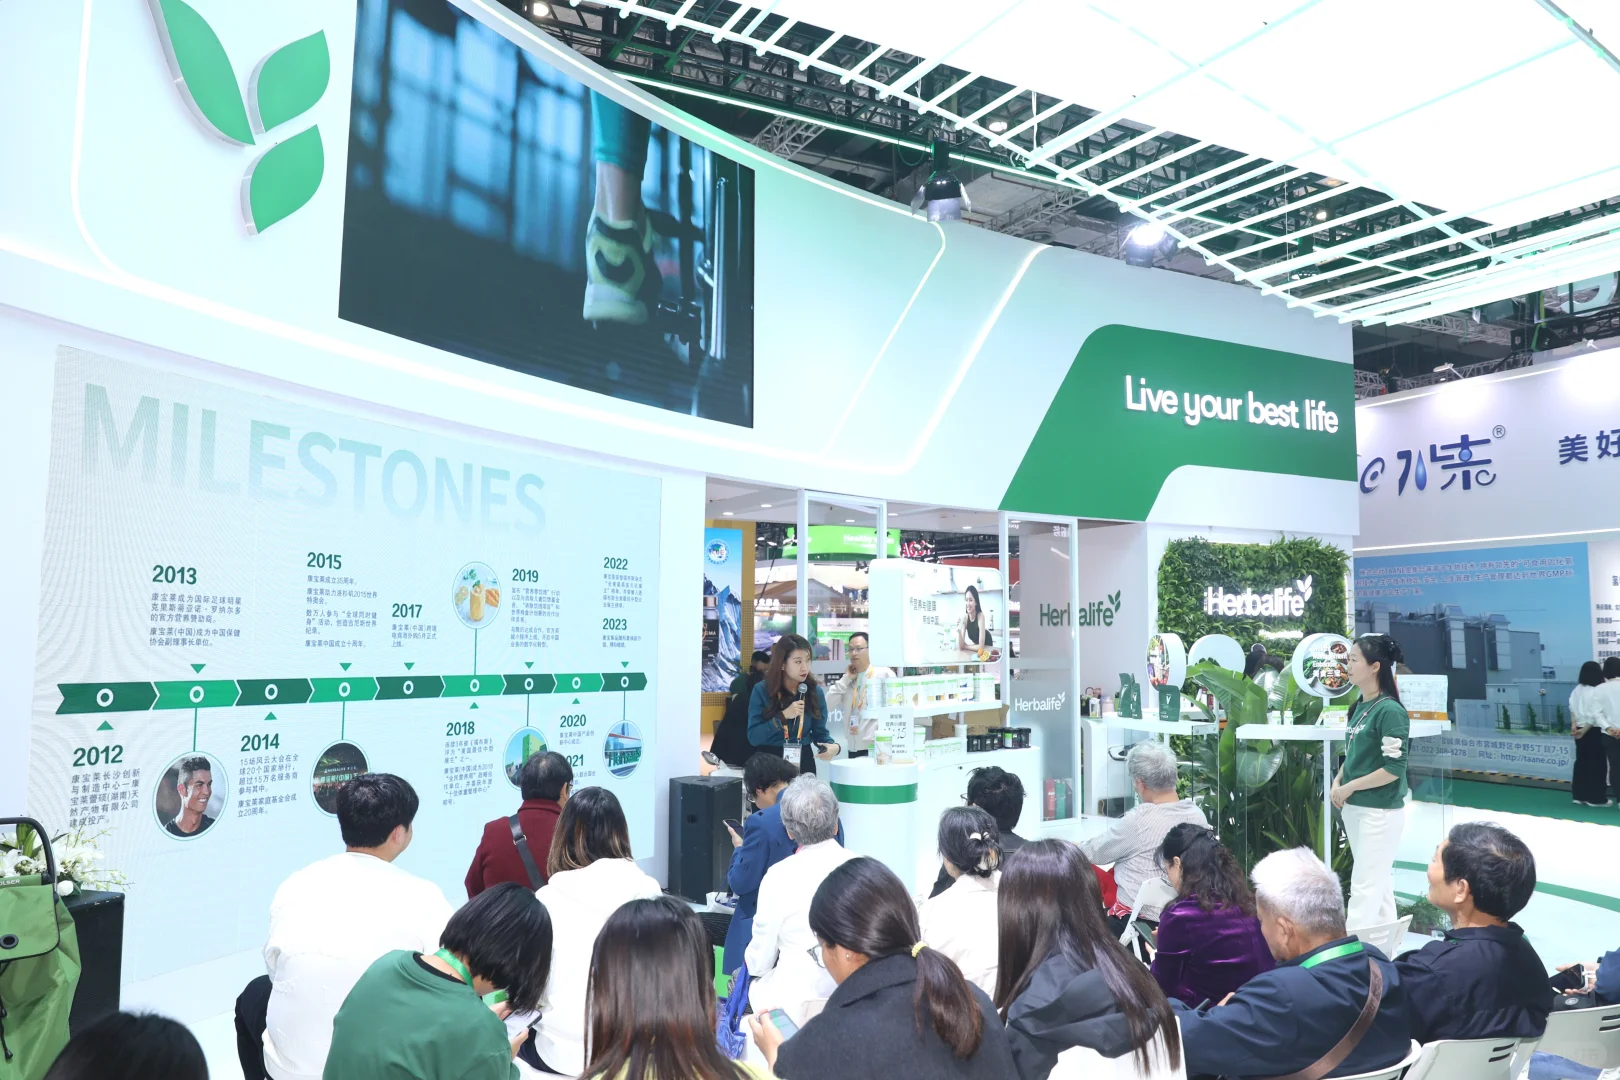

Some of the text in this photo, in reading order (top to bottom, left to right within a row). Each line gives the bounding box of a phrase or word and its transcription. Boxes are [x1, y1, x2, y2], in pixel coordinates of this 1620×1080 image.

[1124, 374, 1338, 433] Live your best life
[81, 382, 547, 535] MILESTONES
[307, 552, 342, 570] 2015
[603, 556, 628, 570] 2022
[152, 564, 197, 585] 2013
[512, 568, 539, 583] 2019
[150, 593, 242, 605] 康宝莱成为国际足球明星
[306, 588, 378, 599] 康宝莱助力洛杉矶2015世界
[150, 603, 241, 615] 克里斯蒂亚诺·罗纳尔多
[1206, 586, 1305, 617] Herbalife
[391, 603, 423, 618] 2017
[150, 613, 217, 624] 的官方营养赞助商。
[602, 617, 628, 631] 2023
[149, 627, 241, 638] 康宝莱(中国)成为中国保健
[149, 637, 214, 647] 协会副理事长单位。
[1014, 696, 1062, 712] Herbalife
[559, 713, 587, 728] 2020
[445, 720, 475, 737] 2018
[240, 732, 280, 753] 2014
[72, 744, 124, 768] 2012
[565, 753, 585, 768] 021
[71, 768, 140, 784] 康宝莱长沙创新
[69, 799, 139, 817] 然产物有限公司
[237, 793, 298, 808] 康宝莱家庭基金会成
[237, 807, 269, 818] 立20周年。
[69, 814, 110, 829] 建成投产。
